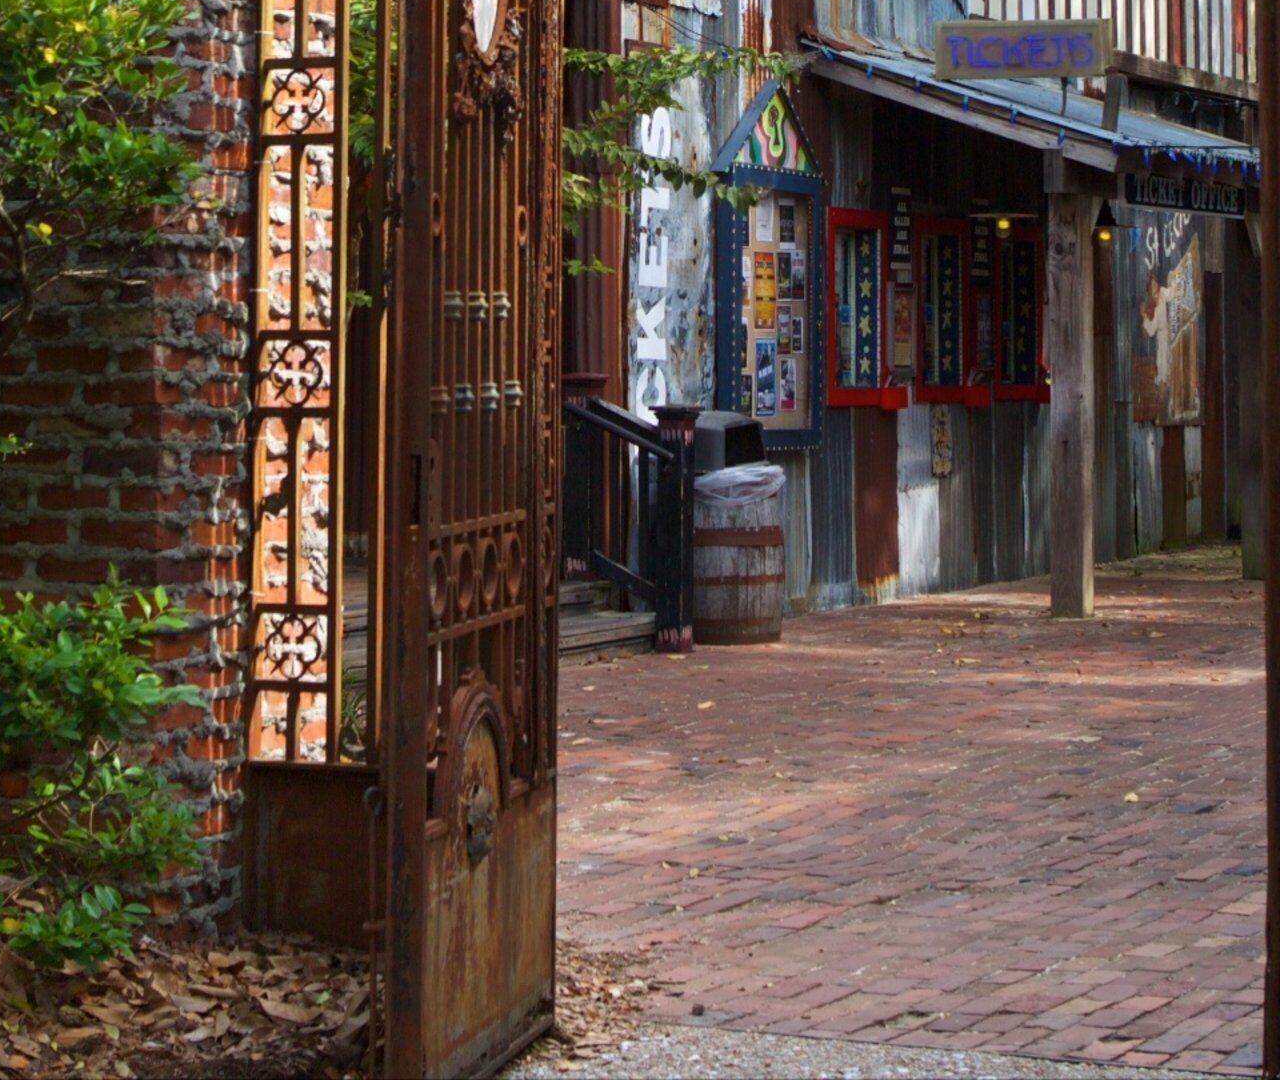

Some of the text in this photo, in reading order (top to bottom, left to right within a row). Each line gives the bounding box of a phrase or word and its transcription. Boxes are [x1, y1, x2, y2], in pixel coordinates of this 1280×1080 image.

[946, 33, 1094, 68] TICKETS
[1135, 175, 1238, 212] TICKET OFFICE
[635, 106, 671, 426] CKETS
